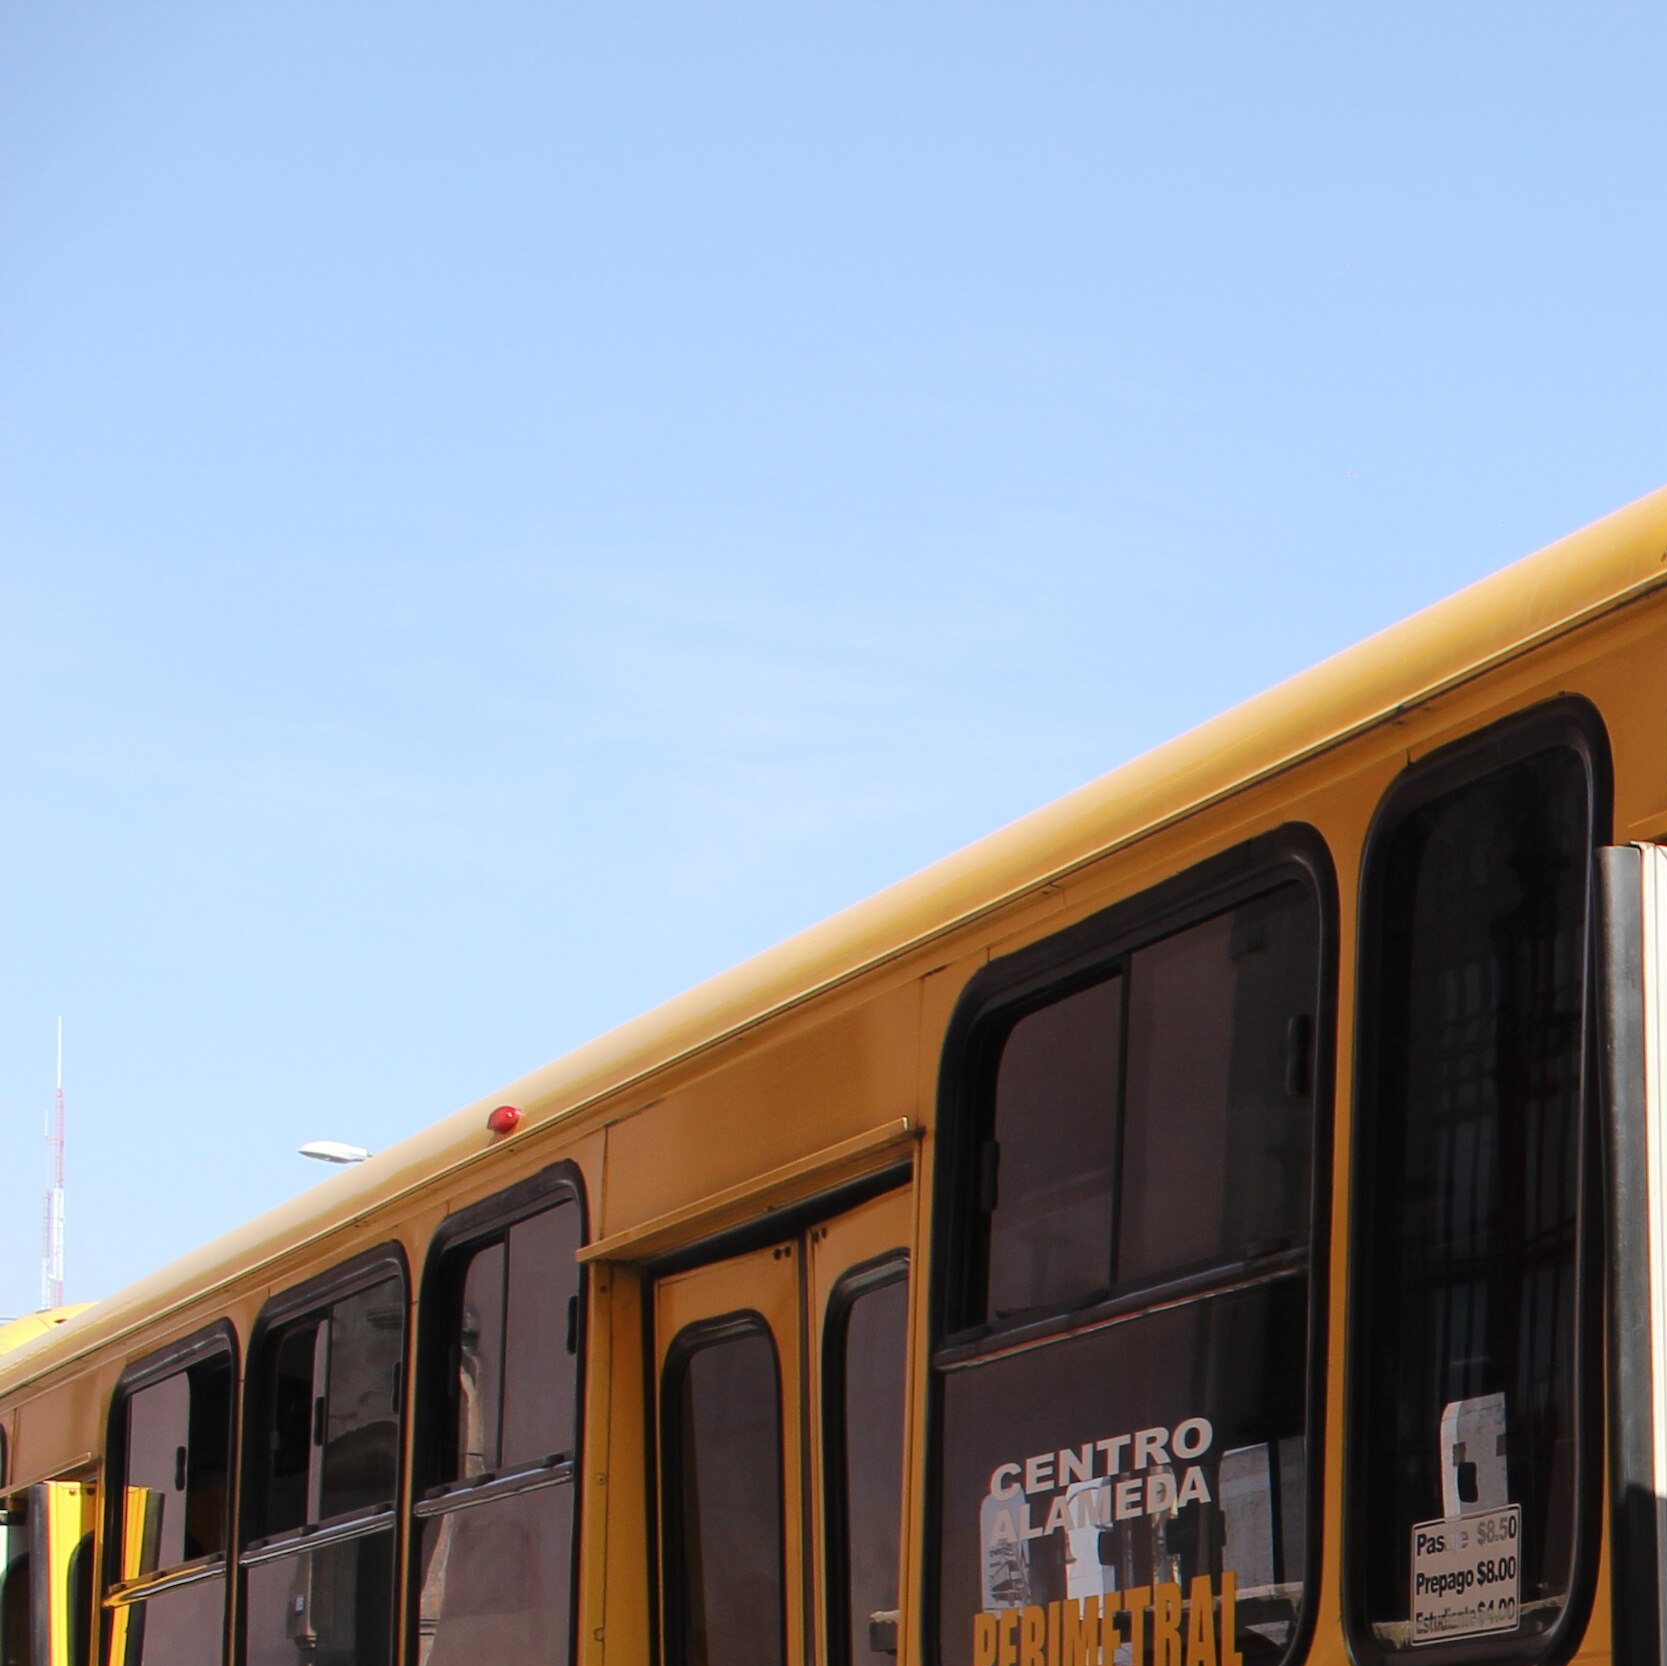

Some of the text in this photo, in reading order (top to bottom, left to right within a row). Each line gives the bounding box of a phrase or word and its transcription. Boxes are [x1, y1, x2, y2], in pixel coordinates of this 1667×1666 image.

[989, 1417, 1213, 1500] CENTRO
[988, 1466, 1212, 1545] ALAMEDA
[1417, 1514, 1518, 1557] Pase $8.50
[1416, 1556, 1517, 1598] Prepago $8.00
